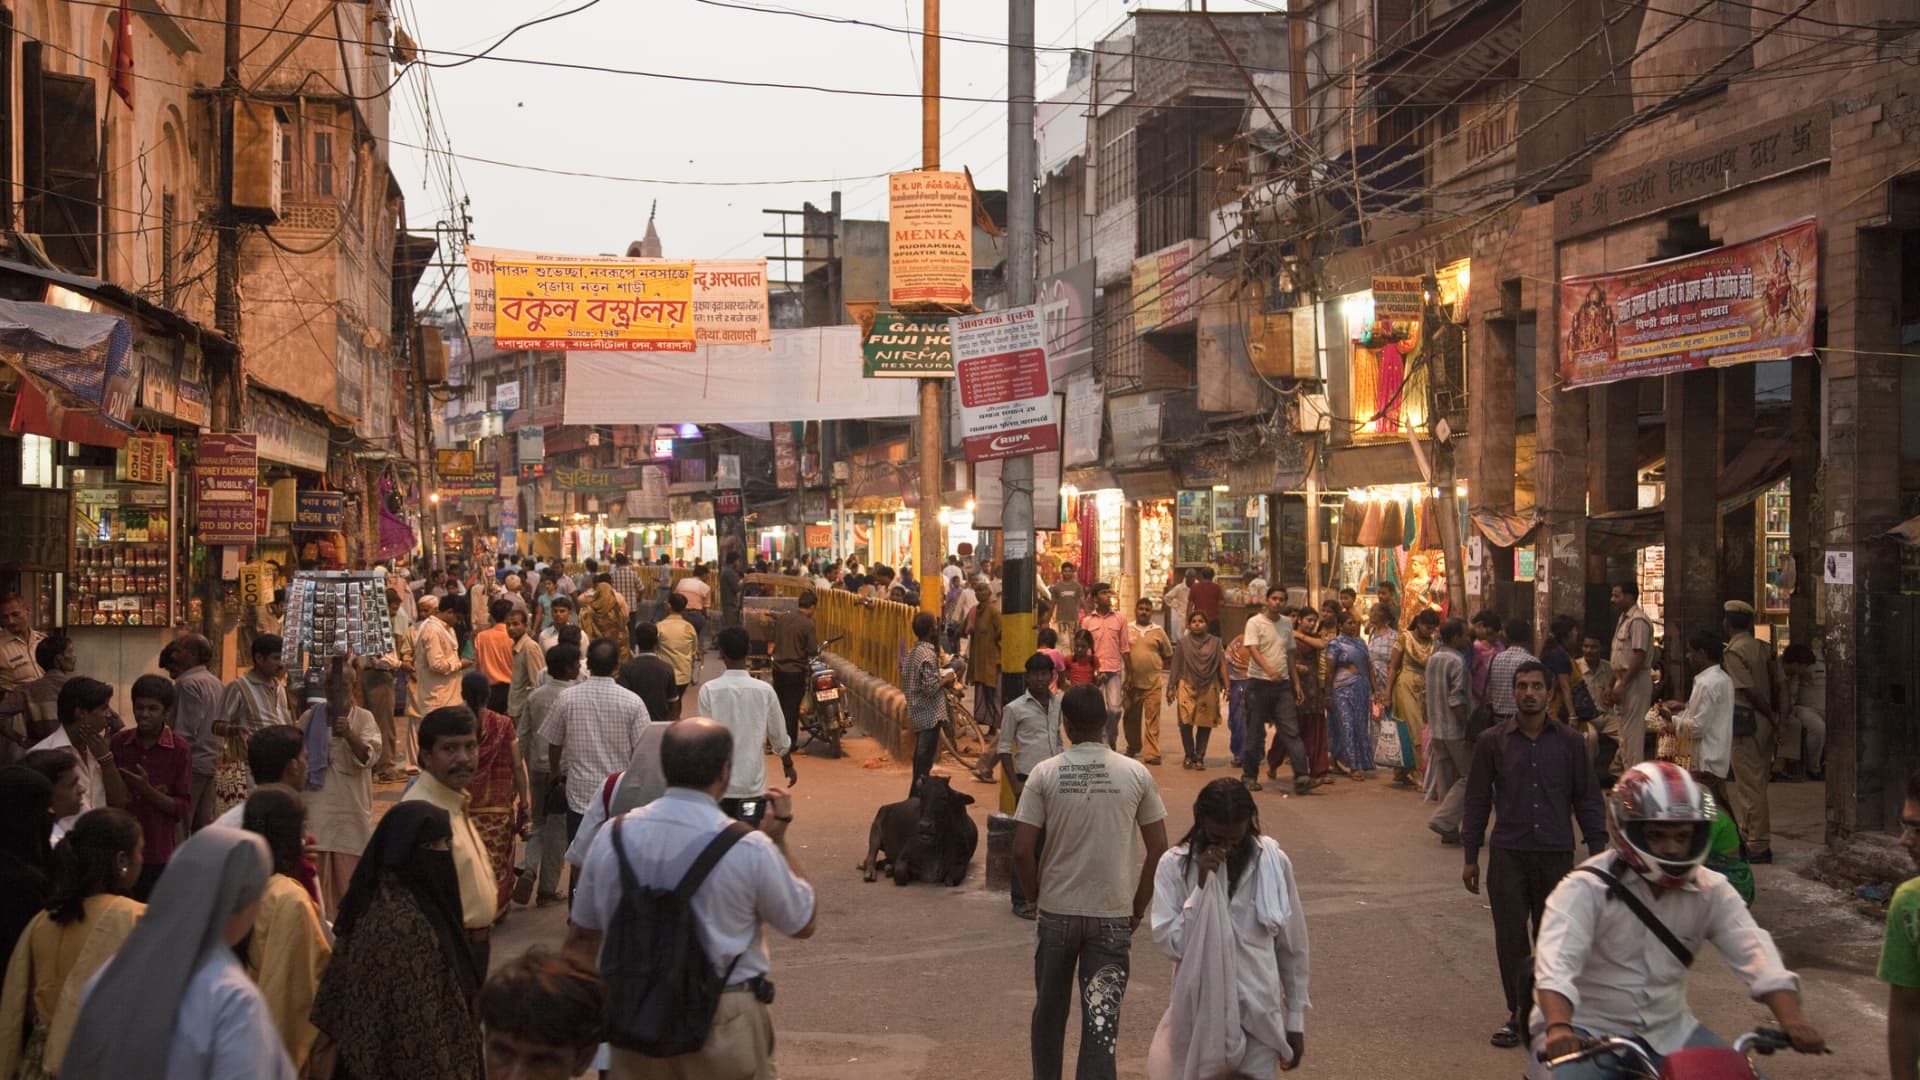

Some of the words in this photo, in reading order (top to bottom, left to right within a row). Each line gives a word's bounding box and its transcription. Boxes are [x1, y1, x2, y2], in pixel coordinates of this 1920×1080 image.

[1592, 184, 1608, 216] श्री
[1618, 170, 1656, 204] काशी
[1667, 149, 1738, 192] विश्वनाथ
[895, 229, 967, 242] MENKA
[496, 266, 528, 279] শারদ
[590, 267, 636, 280] নবরূপে
[694, 272, 710, 292] न्दू
[710, 272, 761, 288] अस्पताल
[474, 288, 495, 300] मधुमे
[536, 282, 574, 297] পূজায়
[580, 282, 609, 296] নতুন
[499, 297, 580, 332] বকুল
[586, 296, 688, 330] বস্ত্রালয়
[889, 322, 950, 332] GANG
[722, 328, 757, 341] वाराणसी
[869, 335, 918, 344] FUJI
[924, 336, 952, 344] HO
[875, 350, 950, 360] NIRMA
[1000, 434, 1031, 444] RUPA
[556, 468, 608, 490] सुविधा
[200, 522, 215, 530] STD
[217, 522, 232, 530] ISD
[234, 522, 254, 530] PCO
[245, 574, 258, 603] PCO
